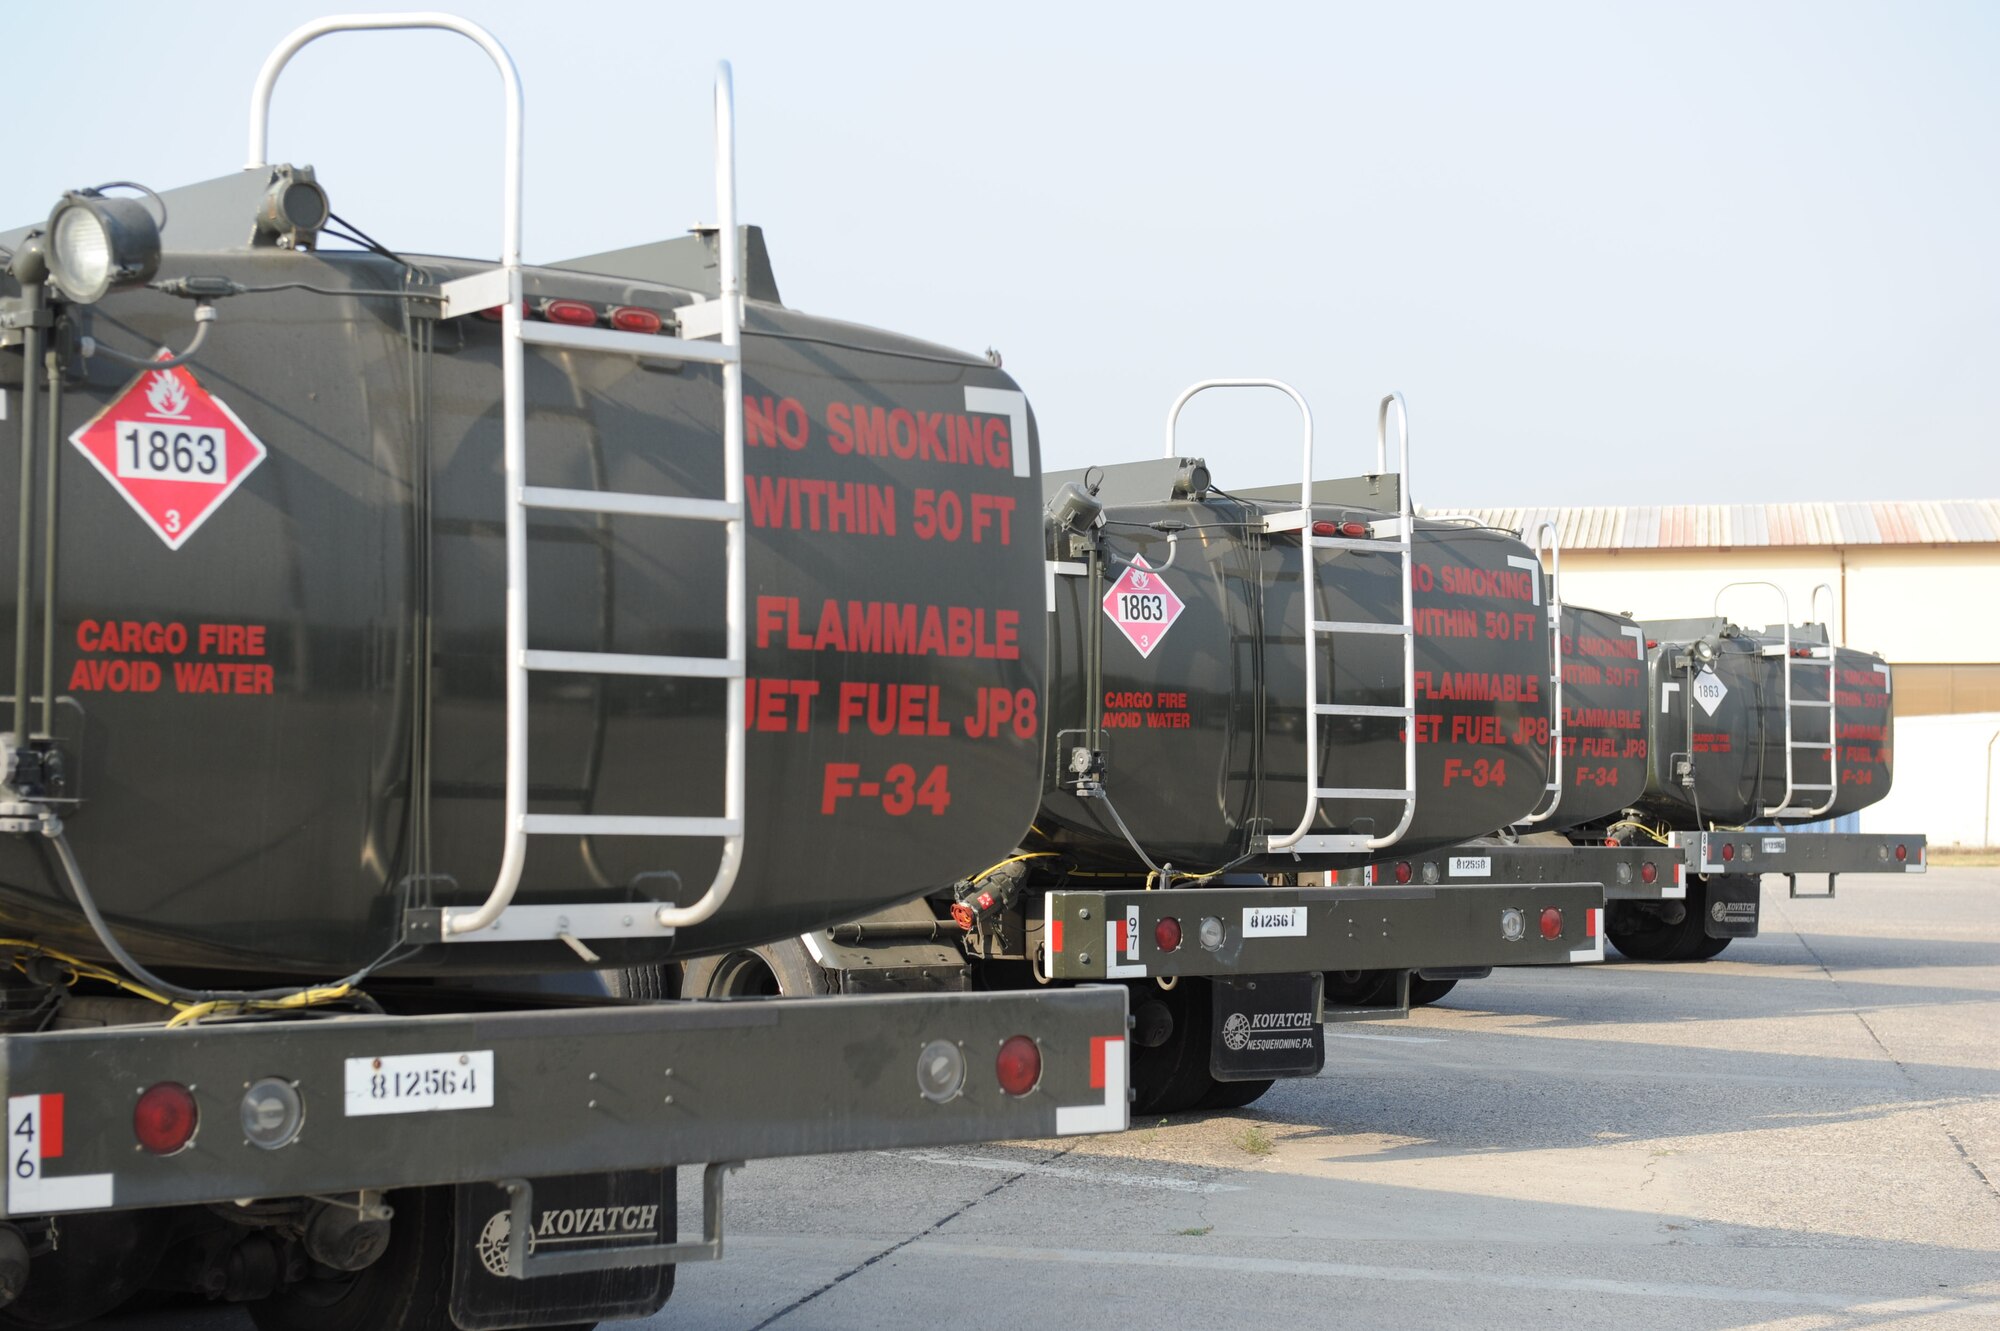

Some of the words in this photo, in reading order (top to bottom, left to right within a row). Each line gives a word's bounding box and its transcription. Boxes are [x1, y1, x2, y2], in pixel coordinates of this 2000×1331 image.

[745, 396, 809, 451] NO
[828, 403, 1011, 469] SMOKING
[125, 430, 217, 475] 1863
[164, 509, 182, 533] 3
[745, 475, 897, 536] WITHIN
[914, 489, 963, 541] 50
[972, 494, 1016, 545] FT
[1441, 567, 1532, 601] SMOKING
[1121, 594, 1163, 621] 1863
[76, 619, 188, 655] CARGO
[198, 624, 267, 656] FIRE
[756, 596, 1021, 660] FLAMMABLE
[1140, 634, 1149, 648] 3
[1486, 611, 1510, 641] 50
[1513, 613, 1536, 641] FT
[68, 659, 162, 693] AVOID
[174, 663, 274, 695] WATER
[1413, 671, 1540, 702] FLAMMABLE
[1624, 668, 1639, 688] FT
[1699, 685, 1720, 698] 1863
[837, 682, 952, 737] FUEL
[963, 687, 1038, 740] JP8
[1104, 691, 1154, 709] CARGO
[1157, 692, 1187, 710] FIRE
[1101, 712, 1142, 729] AVOID
[1146, 713, 1191, 729] WATER
[1451, 715, 1507, 745] FUEL
[1513, 717, 1549, 747] JP8
[1582, 737, 1619, 759] FUEL
[1622, 739, 1647, 759] JP8
[1443, 758, 1507, 788] F-34
[1575, 767, 1619, 787] F-34
[821, 763, 952, 816] F-34
[1250, 914, 1295, 929] 812561
[1251, 1012, 1312, 1028] KOVATCH
[371, 1069, 476, 1098] 812564
[538, 1204, 658, 1236] KOVATCH
